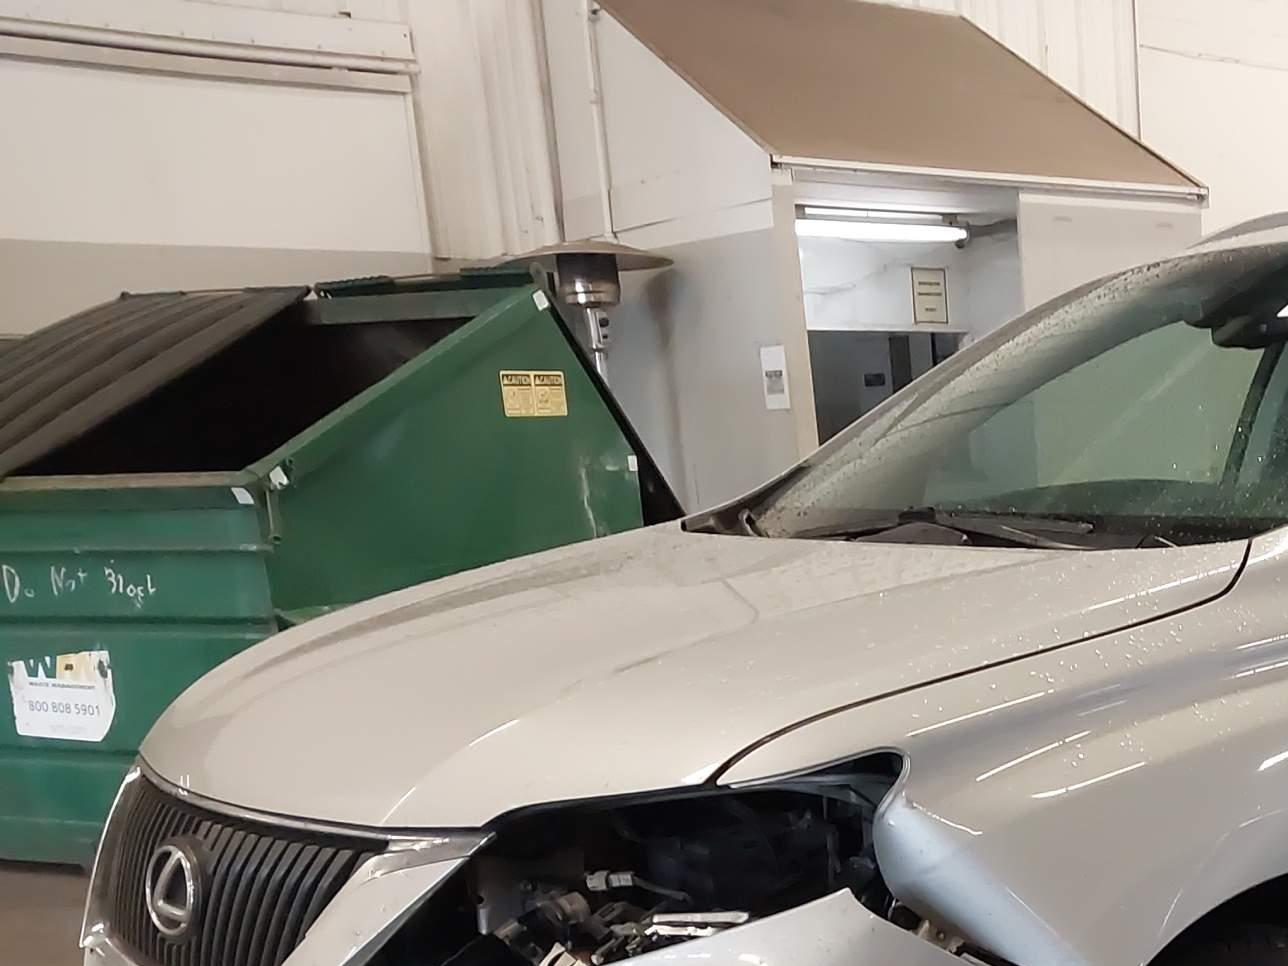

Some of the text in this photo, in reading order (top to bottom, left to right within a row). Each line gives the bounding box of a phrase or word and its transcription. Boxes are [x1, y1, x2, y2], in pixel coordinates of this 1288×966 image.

[2, 564, 35, 603] Do
[51, 565, 88, 596] Not
[28, 700, 101, 716] 800 808 5901
